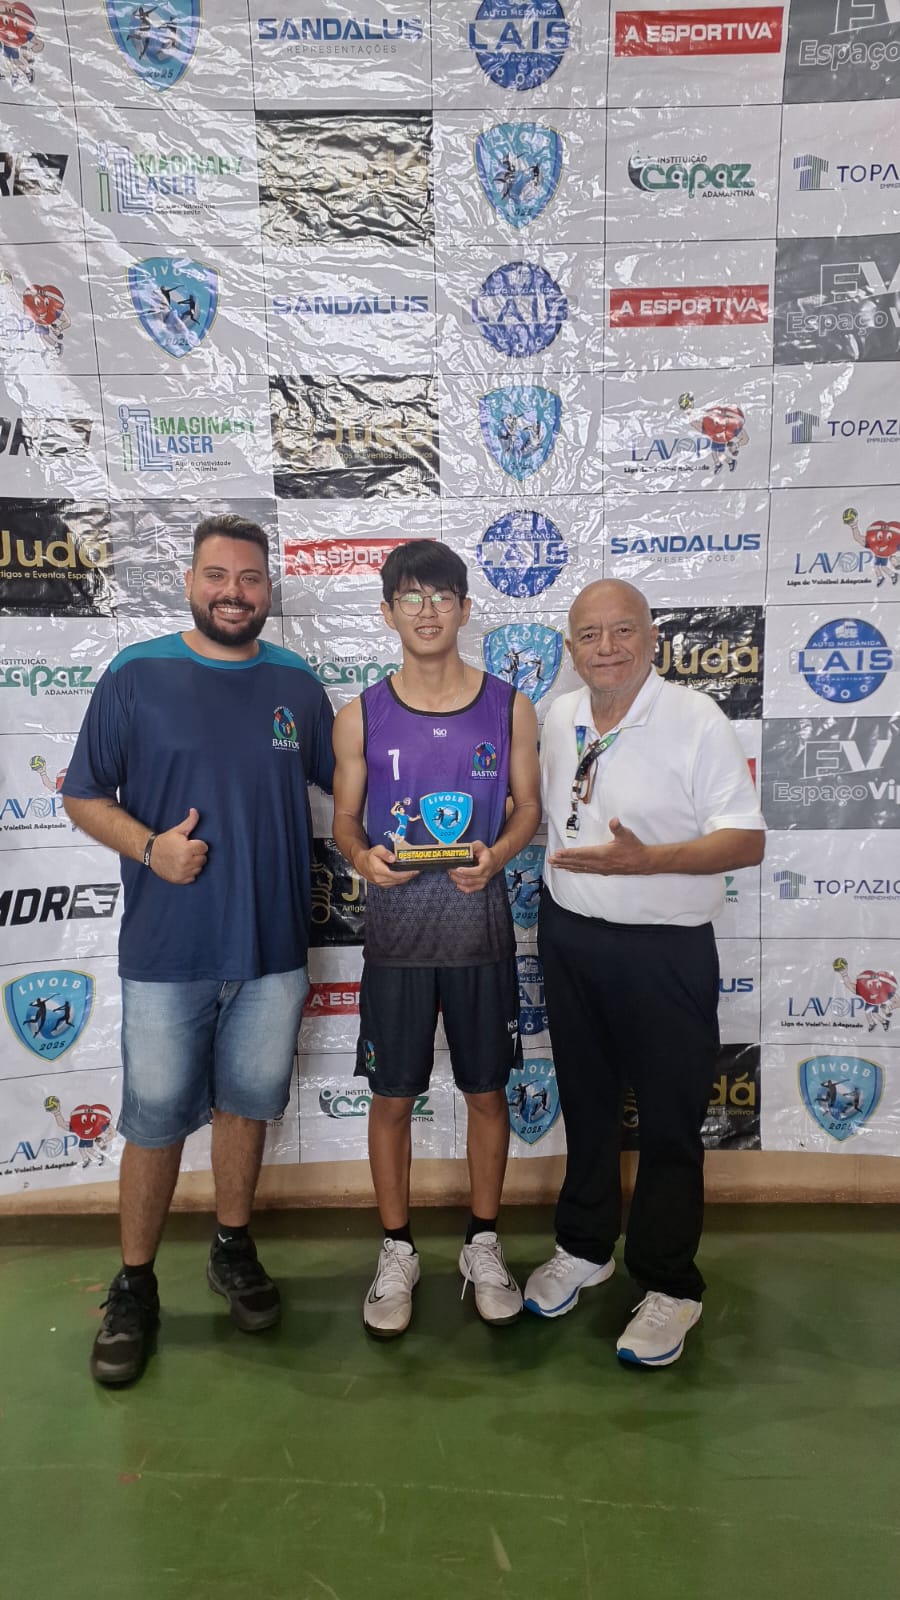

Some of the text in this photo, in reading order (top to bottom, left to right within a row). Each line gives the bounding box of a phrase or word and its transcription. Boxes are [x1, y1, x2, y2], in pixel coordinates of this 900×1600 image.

[258, 18, 423, 40] SANDALUS
[469, 21, 570, 50] LAIS
[625, 22, 773, 43] A ESPORTIVA
[286, 45, 397, 55] REPRESENTAÇÕES
[657, 154, 708, 165] INSTITUIÇÃO
[702, 189, 755, 198] ADAMANTINA
[272, 295, 429, 315] SANDALUS
[472, 297, 568, 322] LAIS
[620, 297, 760, 316] A ESPORTIVA
[827, 419, 900, 437] TOPAZ
[157, 435, 213, 454] LASER
[611, 533, 761, 554] SANDALUS
[476, 543, 569, 566] LAIS
[33, 571, 66, 579] Eventos
[656, 636, 759, 675] Judá
[799, 649, 893, 672] LAIS
[272, 738, 300, 750] BASTOS
[428, 795, 464, 805] LIVOLB
[398, 850, 431, 859] DESTAQUE
[442, 849, 469, 857] PARTIDA
[19, 977, 82, 995] LIVOLB
[310, 993, 324, 1007] A
[39, 1041, 66, 1051] 2025
[811, 1063, 871, 1077] LIVOLB
